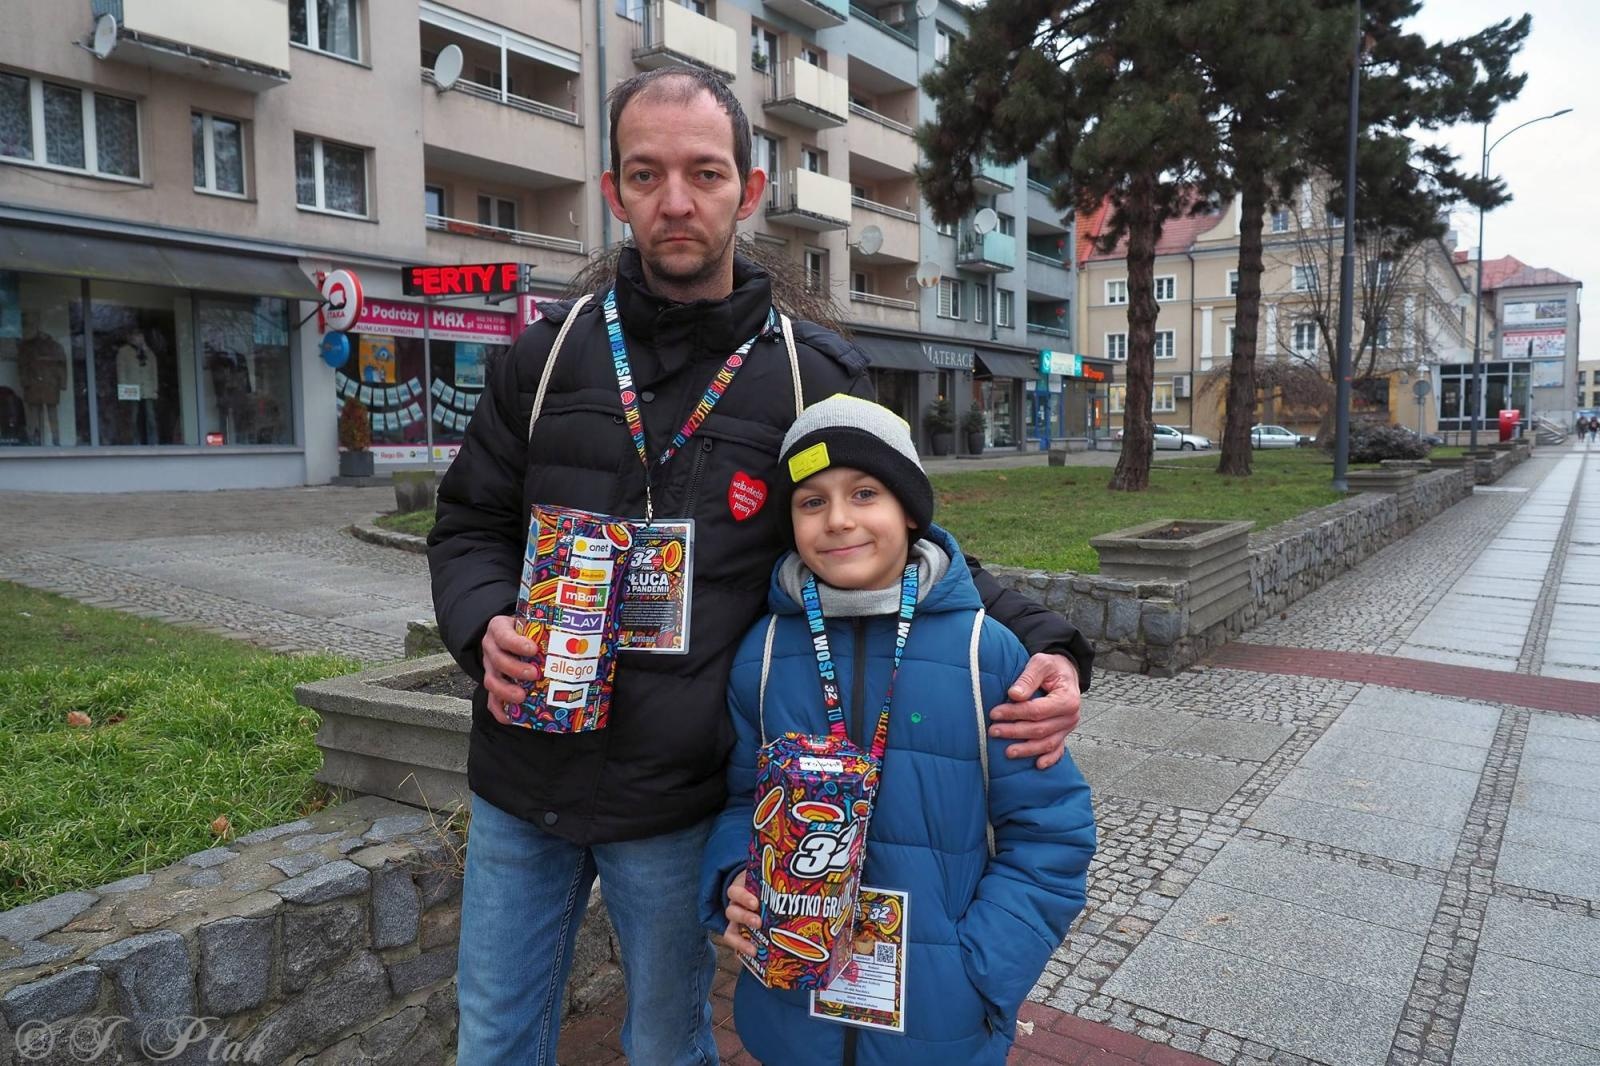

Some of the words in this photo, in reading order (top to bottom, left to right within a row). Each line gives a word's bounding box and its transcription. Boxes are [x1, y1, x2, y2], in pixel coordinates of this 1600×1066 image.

[372, 305, 420, 324] Podróży
[607, 323, 633, 390] WSPIERAM
[922, 344, 974, 368] MATERACE
[672, 435, 686, 448] TU
[681, 395, 717, 438] WSZYSTKO
[589, 543, 609, 553] onet
[630, 548, 657, 568] 32
[565, 591, 603, 603] mBank
[631, 585, 670, 594] PANDEMII
[560, 614, 600, 628] PLAY
[550, 661, 594, 680] allegro
[813, 634, 835, 681] WOŚP
[827, 707, 843, 722] TU
[809, 822, 842, 832] 2024
[795, 823, 858, 874] 32
[769, 887, 820, 917] WSZYSTKO
[869, 906, 890, 920] 32
